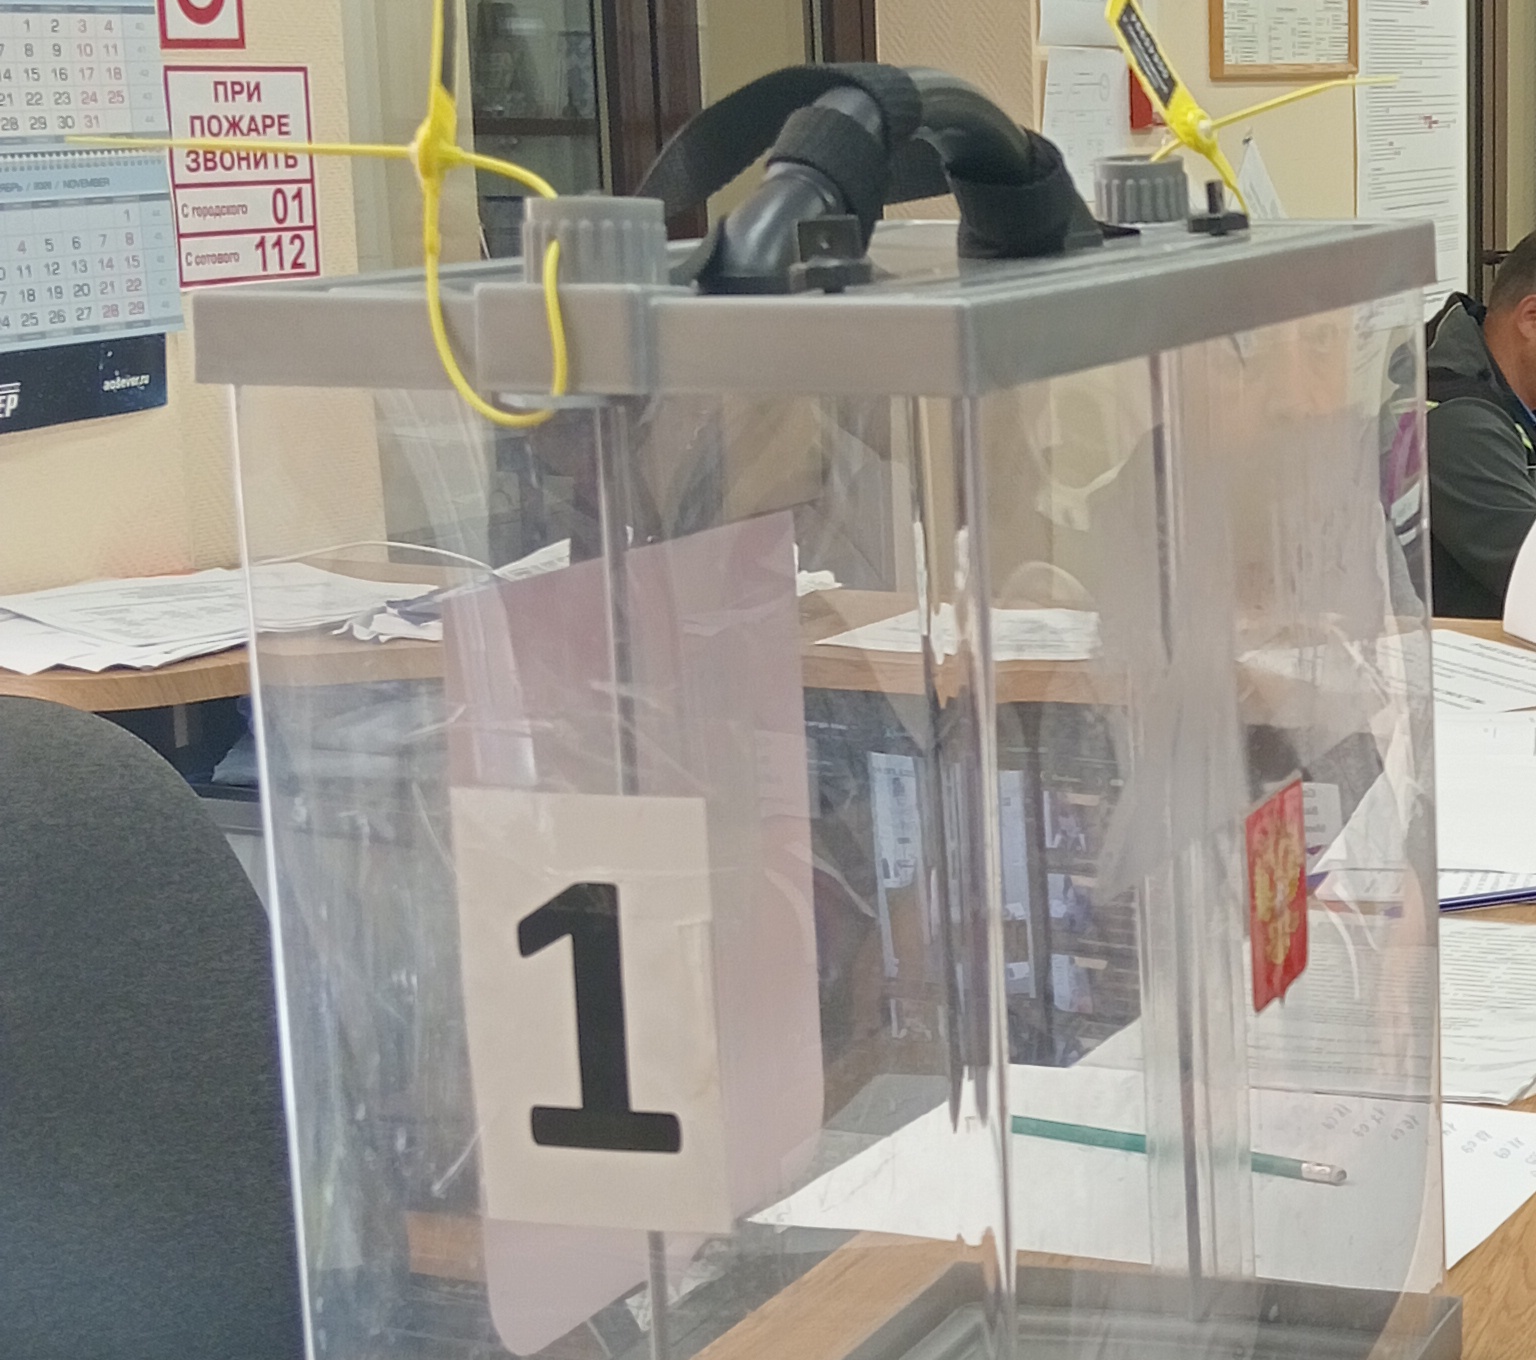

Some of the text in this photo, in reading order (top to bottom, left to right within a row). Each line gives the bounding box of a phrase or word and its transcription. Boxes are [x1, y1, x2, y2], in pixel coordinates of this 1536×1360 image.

[23, 19, 31, 32] 1
[50, 19, 60, 33] 2
[77, 19, 87, 33] 3
[104, 19, 114, 32] 4
[24, 43, 34, 57] 8
[52, 43, 62, 57] 9
[77, 43, 93, 57] 10
[103, 43, 118, 57] 11
[24, 68, 41, 81] 15
[51, 68, 68, 81] 16
[79, 67, 94, 81] 17
[106, 67, 122, 80] 18
[25, 92, 43, 106] 22
[53, 91, 71, 105] 23
[81, 91, 98, 105] 24
[108, 90, 125, 104] 25
[213, 80, 262, 104] ПРИ
[1, 117, 19, 131] 28
[29, 116, 47, 130] 29
[57, 115, 75, 129] 30
[84, 115, 100, 128] 31
[190, 114, 292, 138] ПОЖАРЕ
[185, 147, 298, 173] ЗВОНИТЬ
[124, 209, 131, 223] 1
[181, 186, 305, 226] С городского 01
[17, 232, 134, 254] 4 5 6 7 8
[194, 250, 241, 266] сотового
[254, 233, 307, 273] 112
[17, 265, 32, 279] 11
[44, 262, 60, 276] 12
[72, 259, 88, 274] 13
[98, 257, 114, 271] 14
[125, 255, 141, 269] 15
[19, 289, 36, 303] 18
[47, 286, 64, 300] 19
[73, 283, 91, 298] 20
[100, 281, 116, 295] 21
[126, 278, 142, 293] 22
[21, 313, 39, 328] 25
[48, 310, 66, 324] 26
[75, 307, 92, 322] 27
[102, 304, 120, 318] 28
[128, 301, 146, 316] 29
[516, 881, 683, 1155] 1
